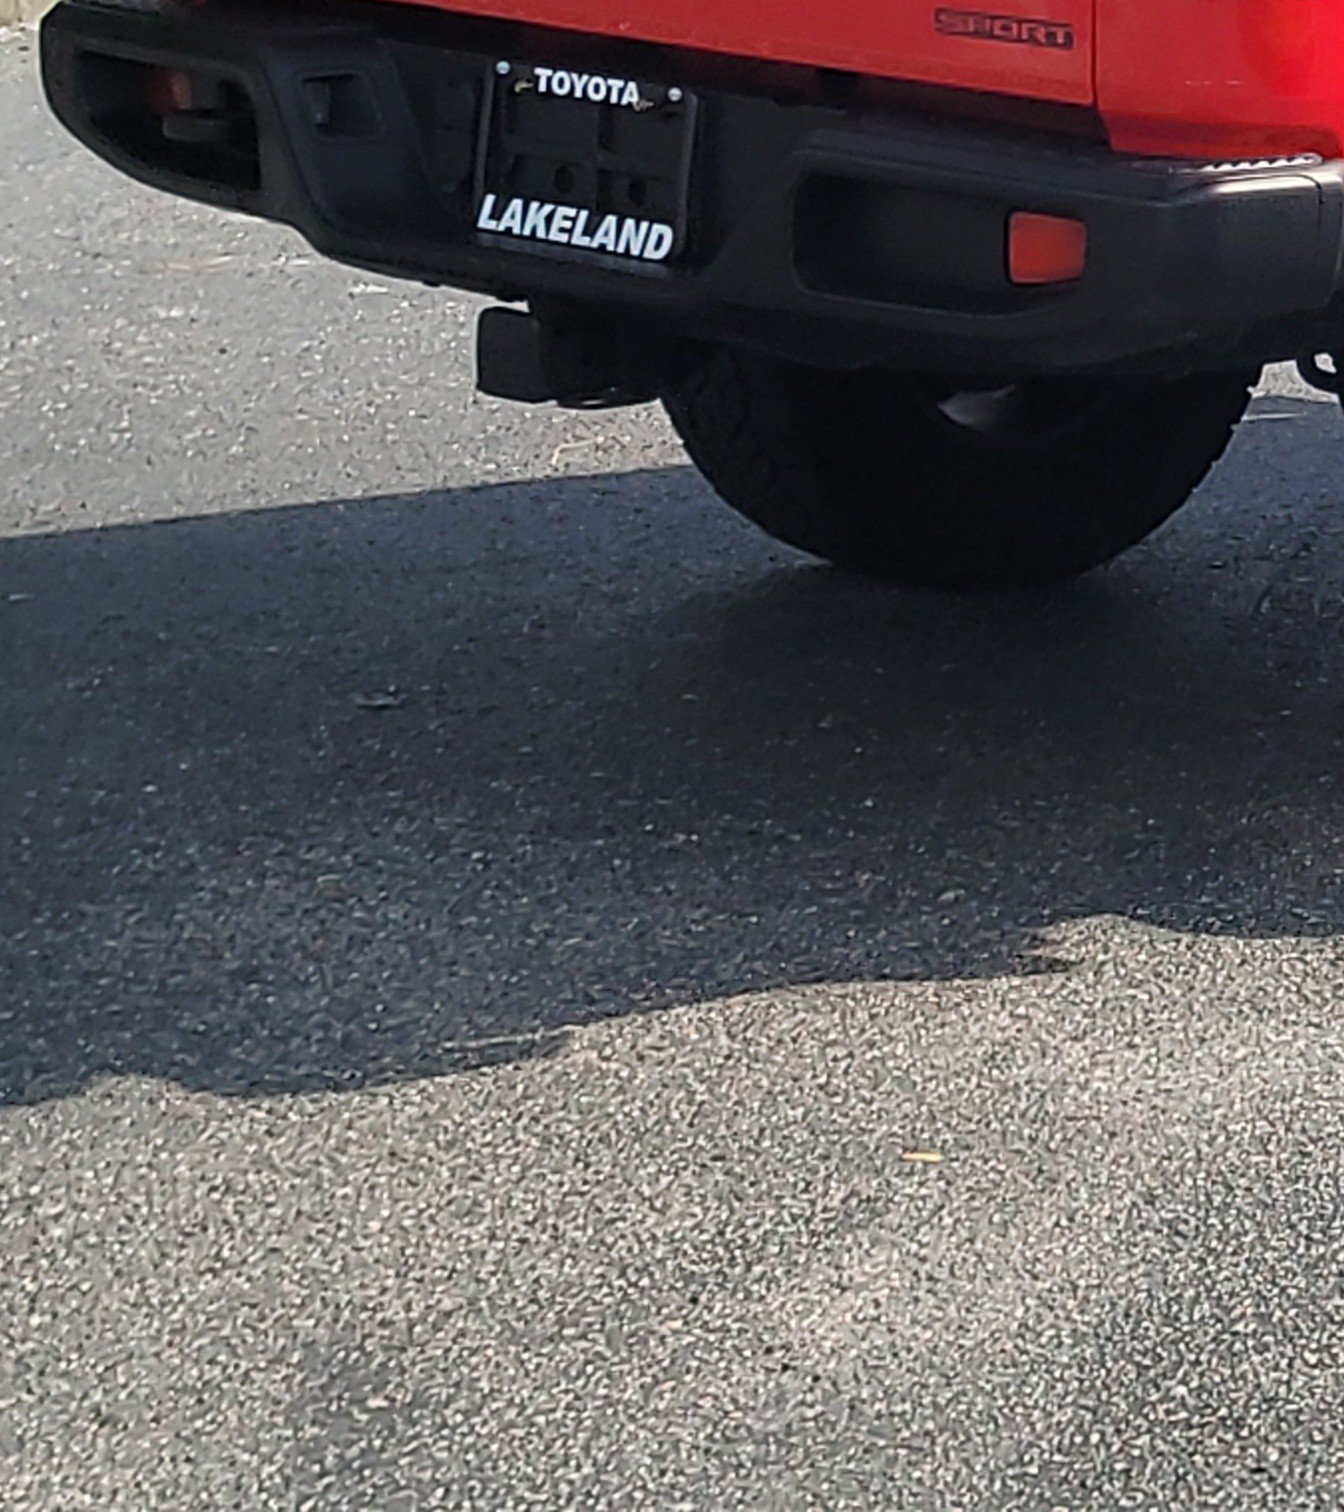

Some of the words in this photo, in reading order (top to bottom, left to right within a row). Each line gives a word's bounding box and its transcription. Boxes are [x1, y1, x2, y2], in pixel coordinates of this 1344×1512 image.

[936, 10, 1071, 49] SPORT
[533, 67, 640, 106] TOYOTA
[476, 193, 674, 260] LAKELAND
